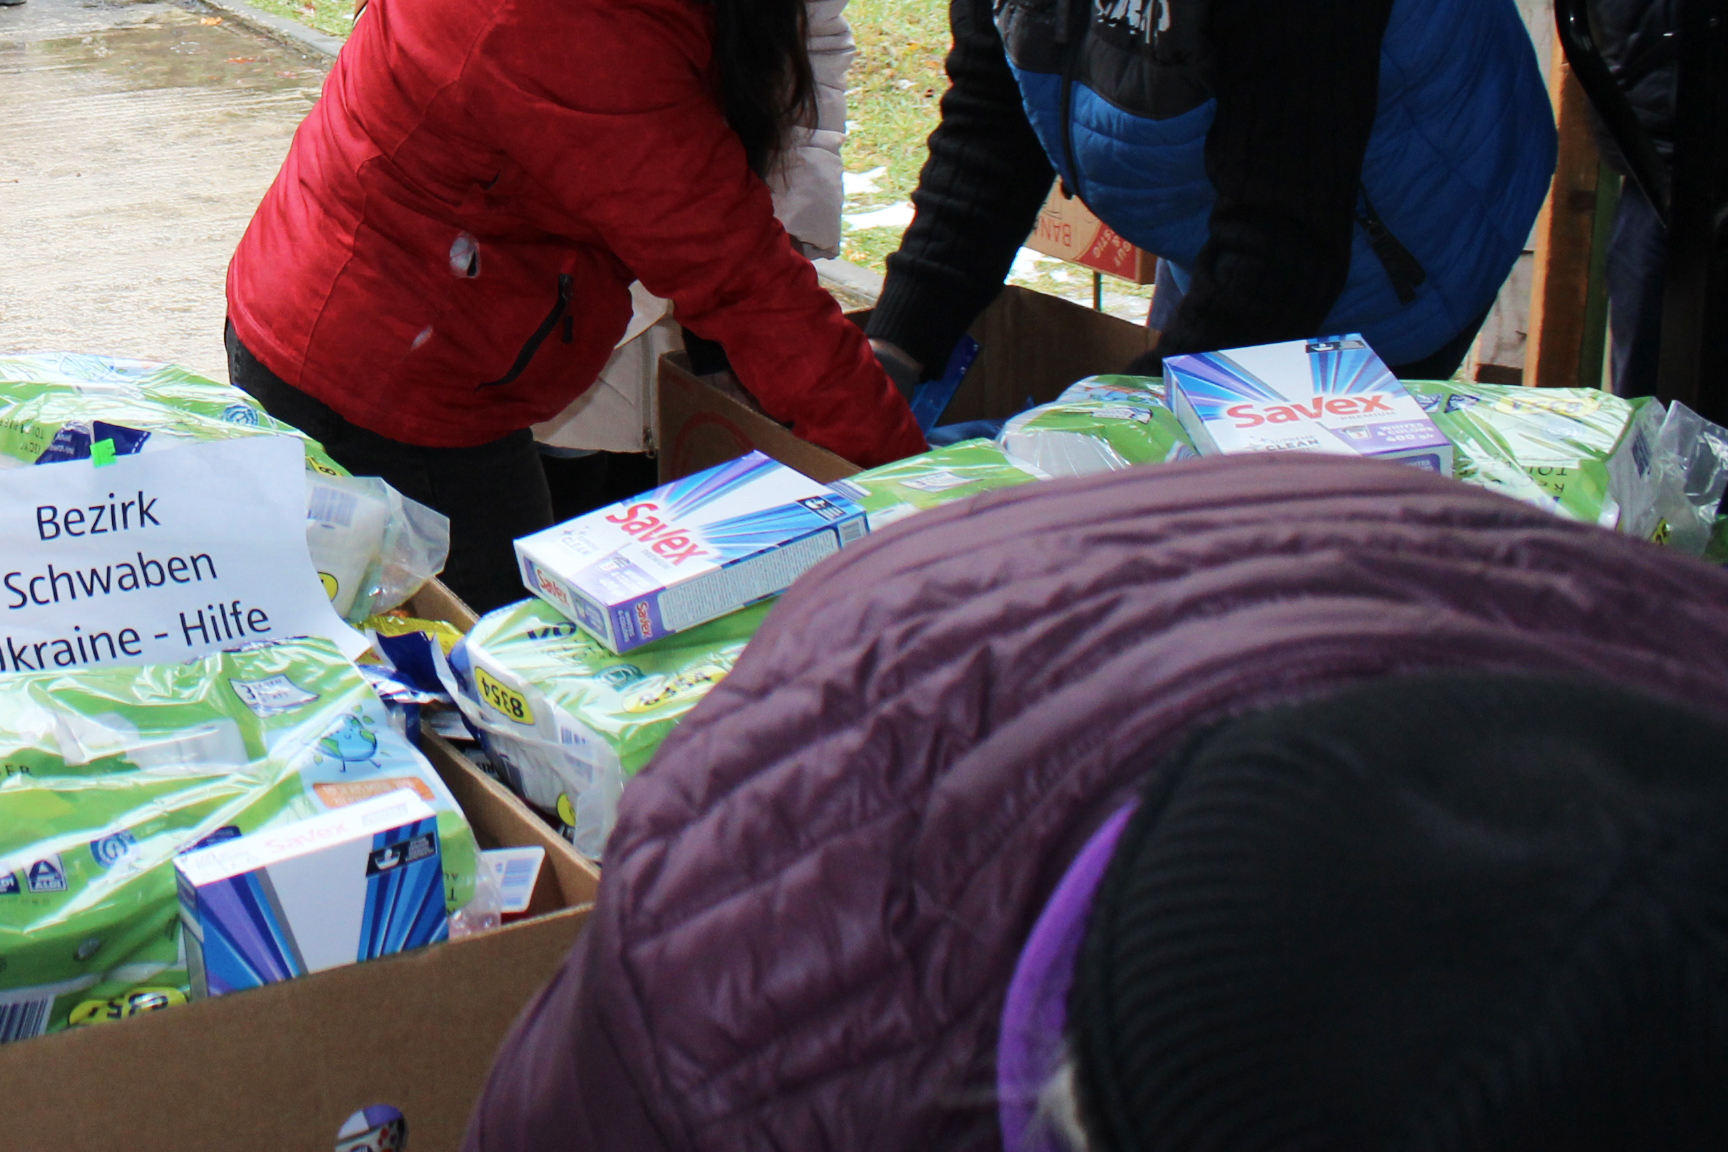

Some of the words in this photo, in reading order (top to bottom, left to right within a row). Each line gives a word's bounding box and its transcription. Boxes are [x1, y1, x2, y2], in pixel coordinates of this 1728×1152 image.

[1227, 394, 1395, 429] Savex
[1339, 410, 1397, 422] PREMIUM
[1378, 422, 1424, 432] WHITES
[1264, 437, 1320, 452] CLEAN
[37, 491, 162, 541] Bezirk
[605, 502, 710, 566] Savex
[4, 547, 218, 611] Schwaben
[536, 568, 570, 607] Savex
[180, 599, 272, 648] Hilfe
[635, 600, 654, 641] Savex
[481, 678, 525, 719] 8354
[265, 821, 352, 850] Savex
[34, 879, 63, 890] ALDI
